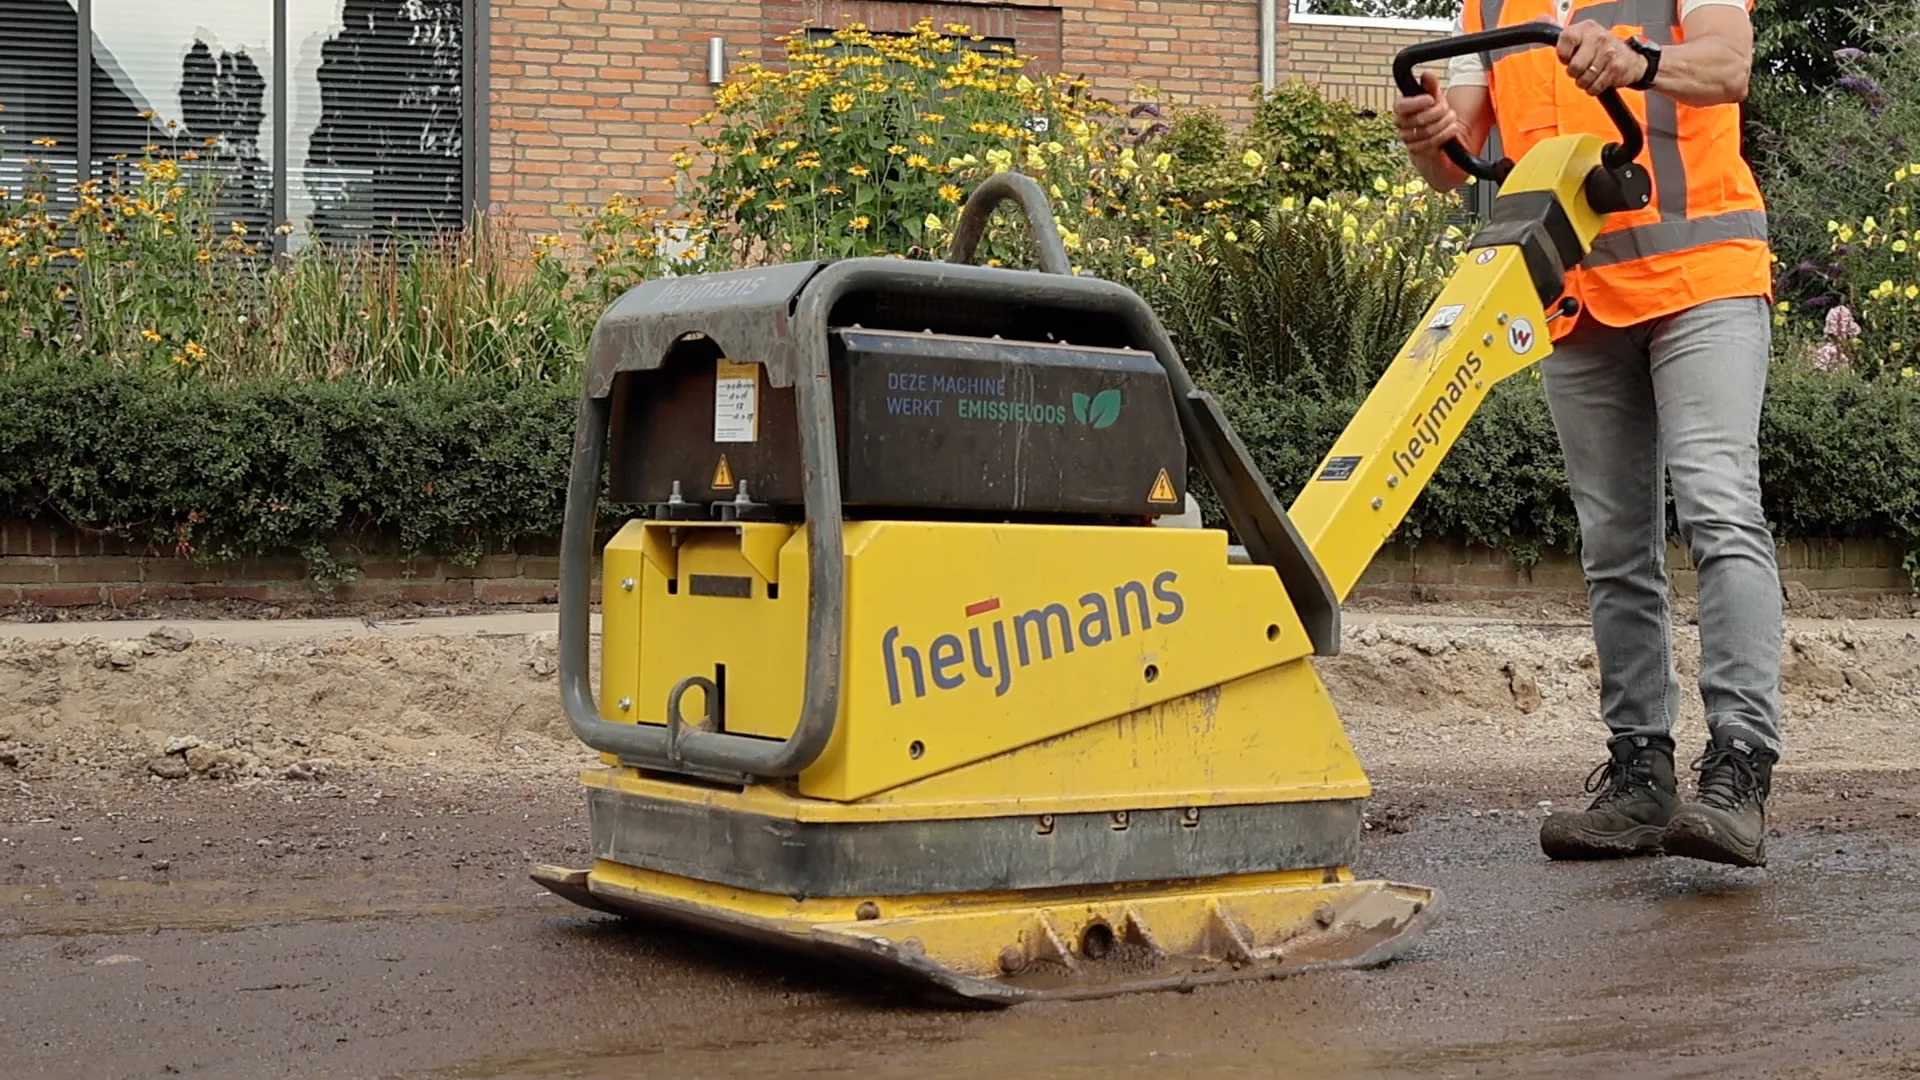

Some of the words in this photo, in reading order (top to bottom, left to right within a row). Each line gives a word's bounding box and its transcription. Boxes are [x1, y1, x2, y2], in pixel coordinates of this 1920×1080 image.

[650, 276, 767, 309] heijmans
[888, 372, 927, 392] DEZE
[932, 375, 1006, 396] MACHINE
[887, 396, 943, 417] WERKT
[958, 400, 1067, 425] EMISSIELOOS
[1392, 350, 1482, 478] heijmans
[882, 569, 1185, 706] heijmans
